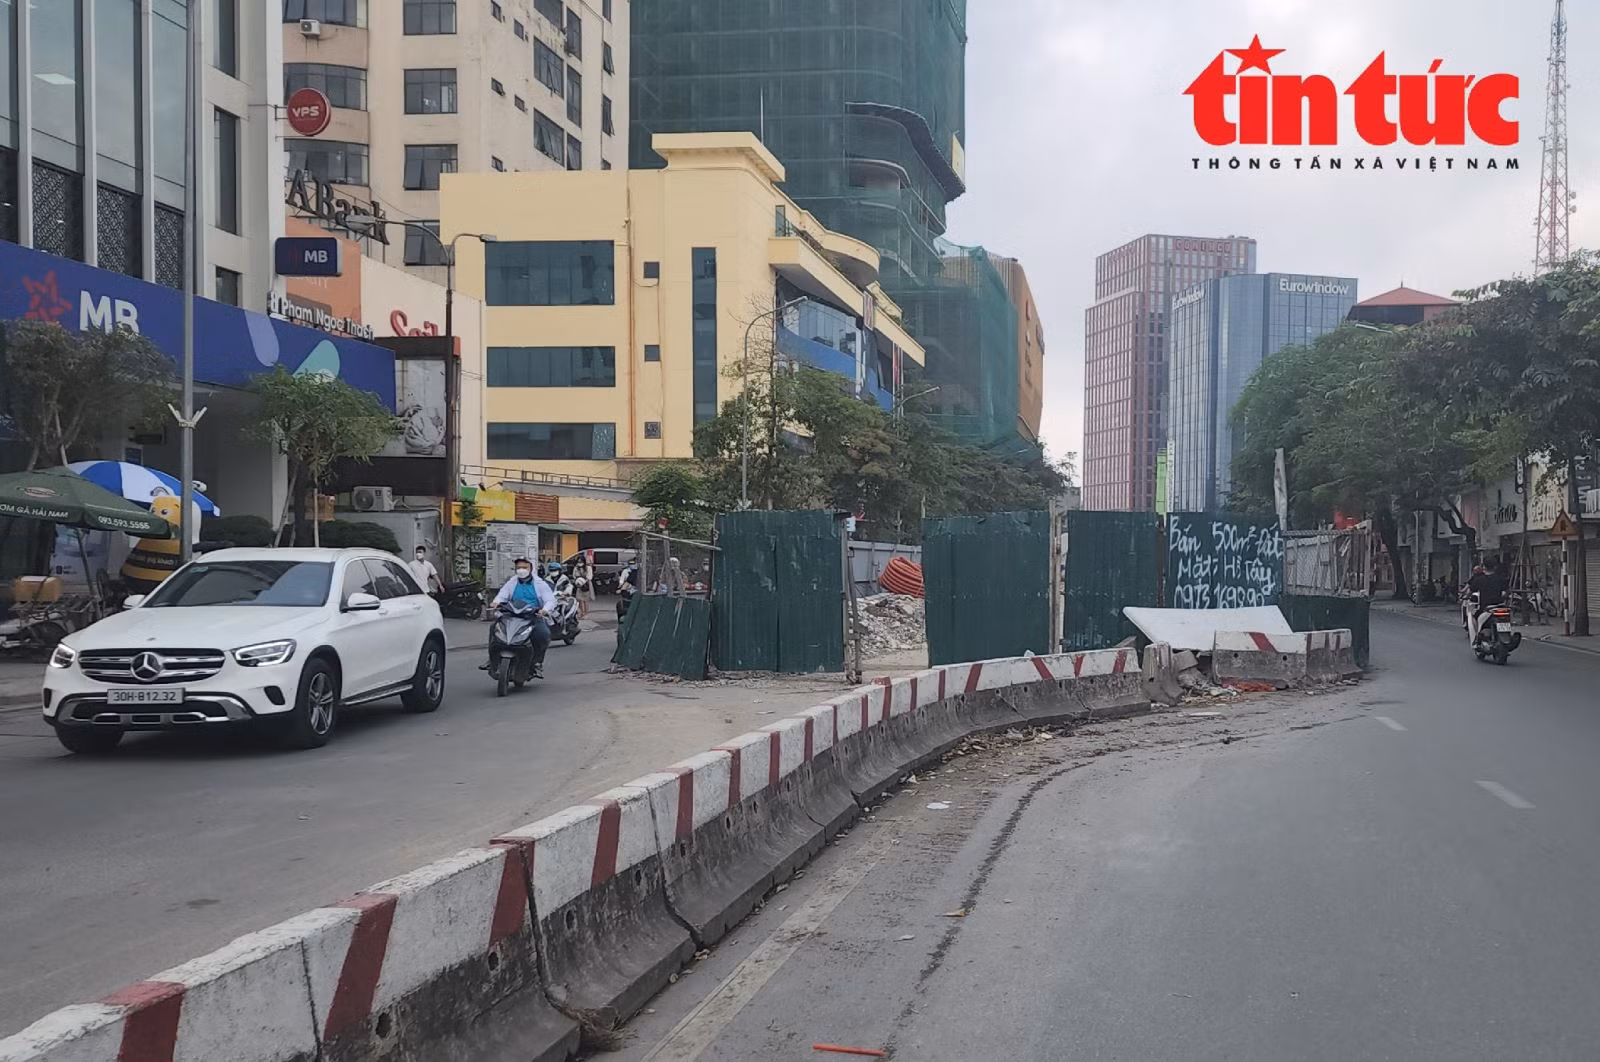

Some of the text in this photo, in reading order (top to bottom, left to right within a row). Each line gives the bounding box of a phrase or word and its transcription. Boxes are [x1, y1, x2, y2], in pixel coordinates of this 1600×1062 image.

[291, 105, 320, 118] VPS
[303, 249, 329, 264] MB
[1278, 277, 1350, 296] Eurowindow
[79, 289, 140, 337] MB
[112, 690, 177, 702] 30H-812.32
